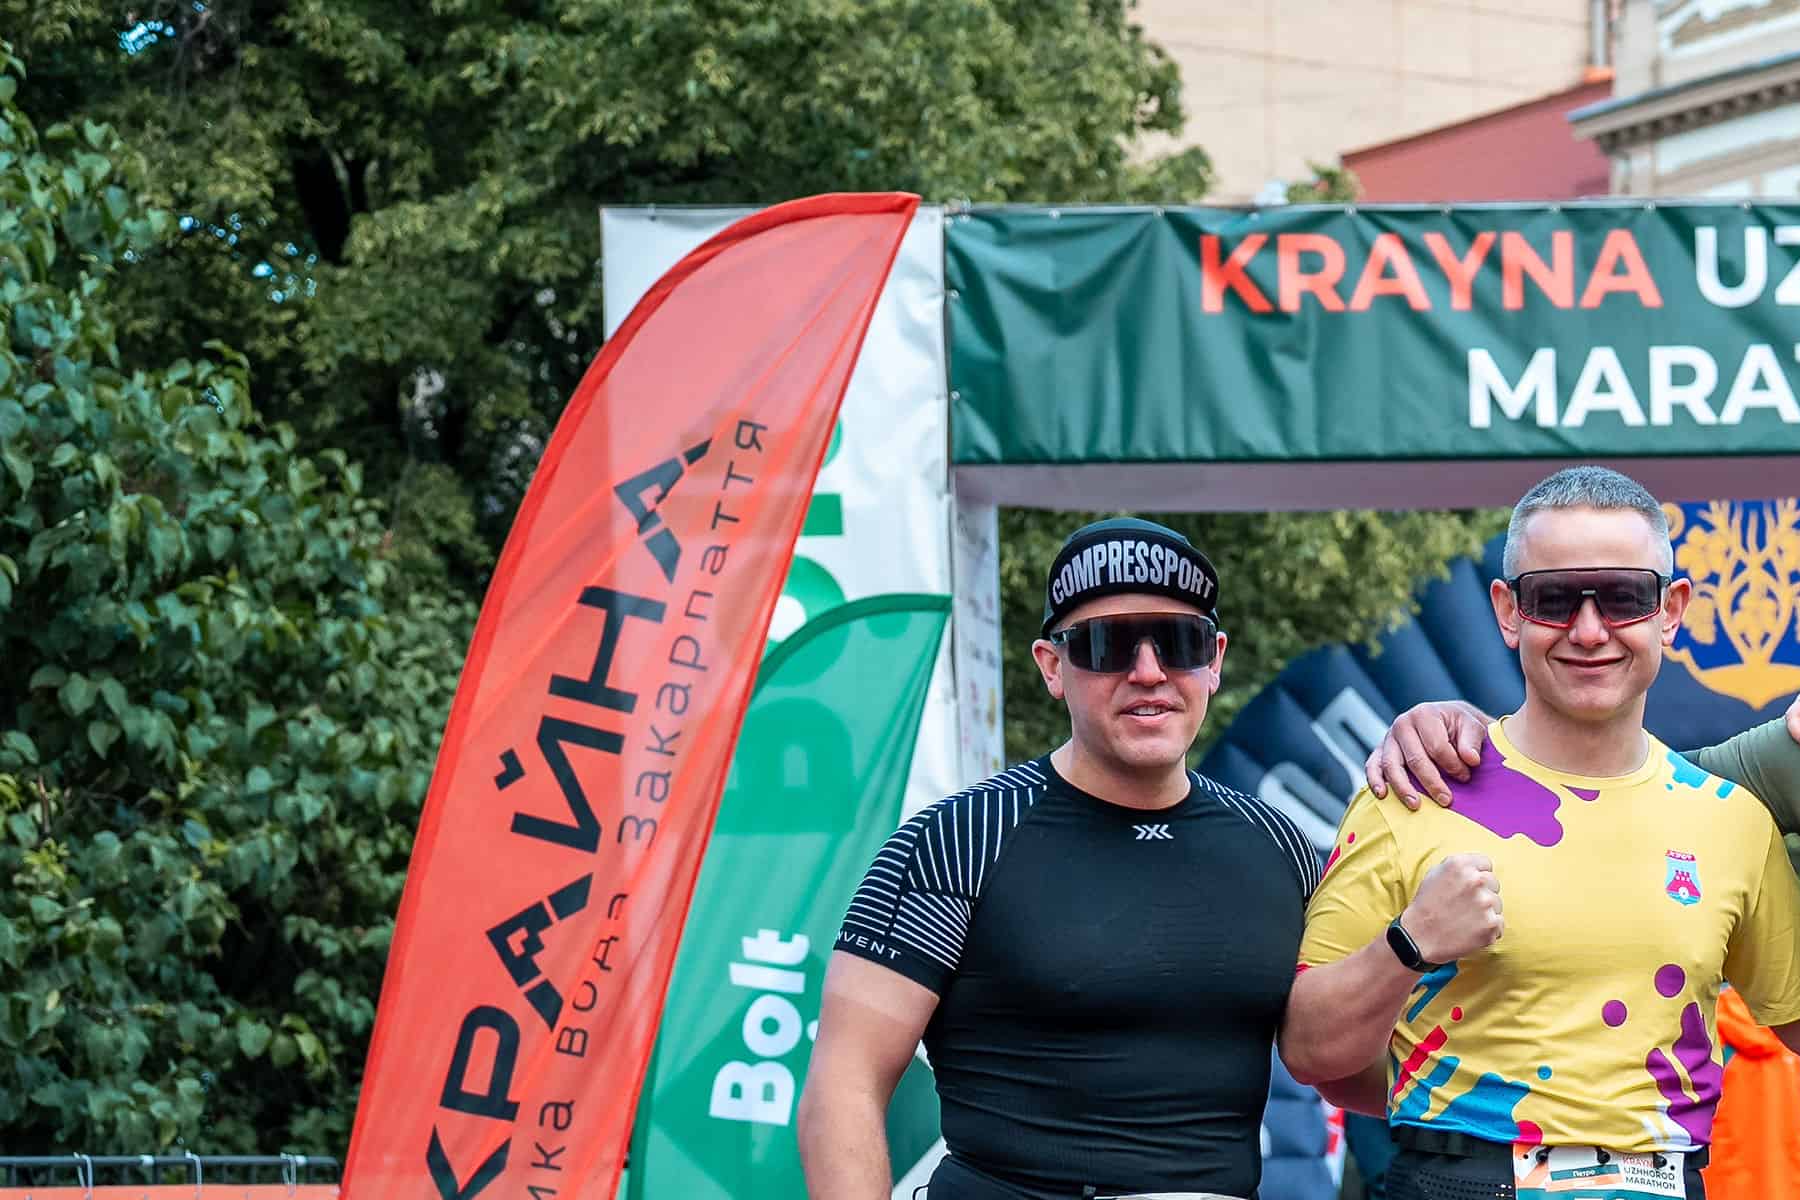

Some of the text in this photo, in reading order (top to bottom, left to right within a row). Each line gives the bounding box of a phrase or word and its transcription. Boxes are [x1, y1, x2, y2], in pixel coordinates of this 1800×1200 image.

[1200, 229, 1664, 314] KRAYNA
[1052, 540, 1215, 605] COMPRESSPORT
[709, 928, 810, 1126] Bolt
[1622, 1157, 1653, 1169] KRAYN
[1623, 1166, 1676, 1181] UZHHOROD
[1625, 1176, 1676, 1190] MARATHON
